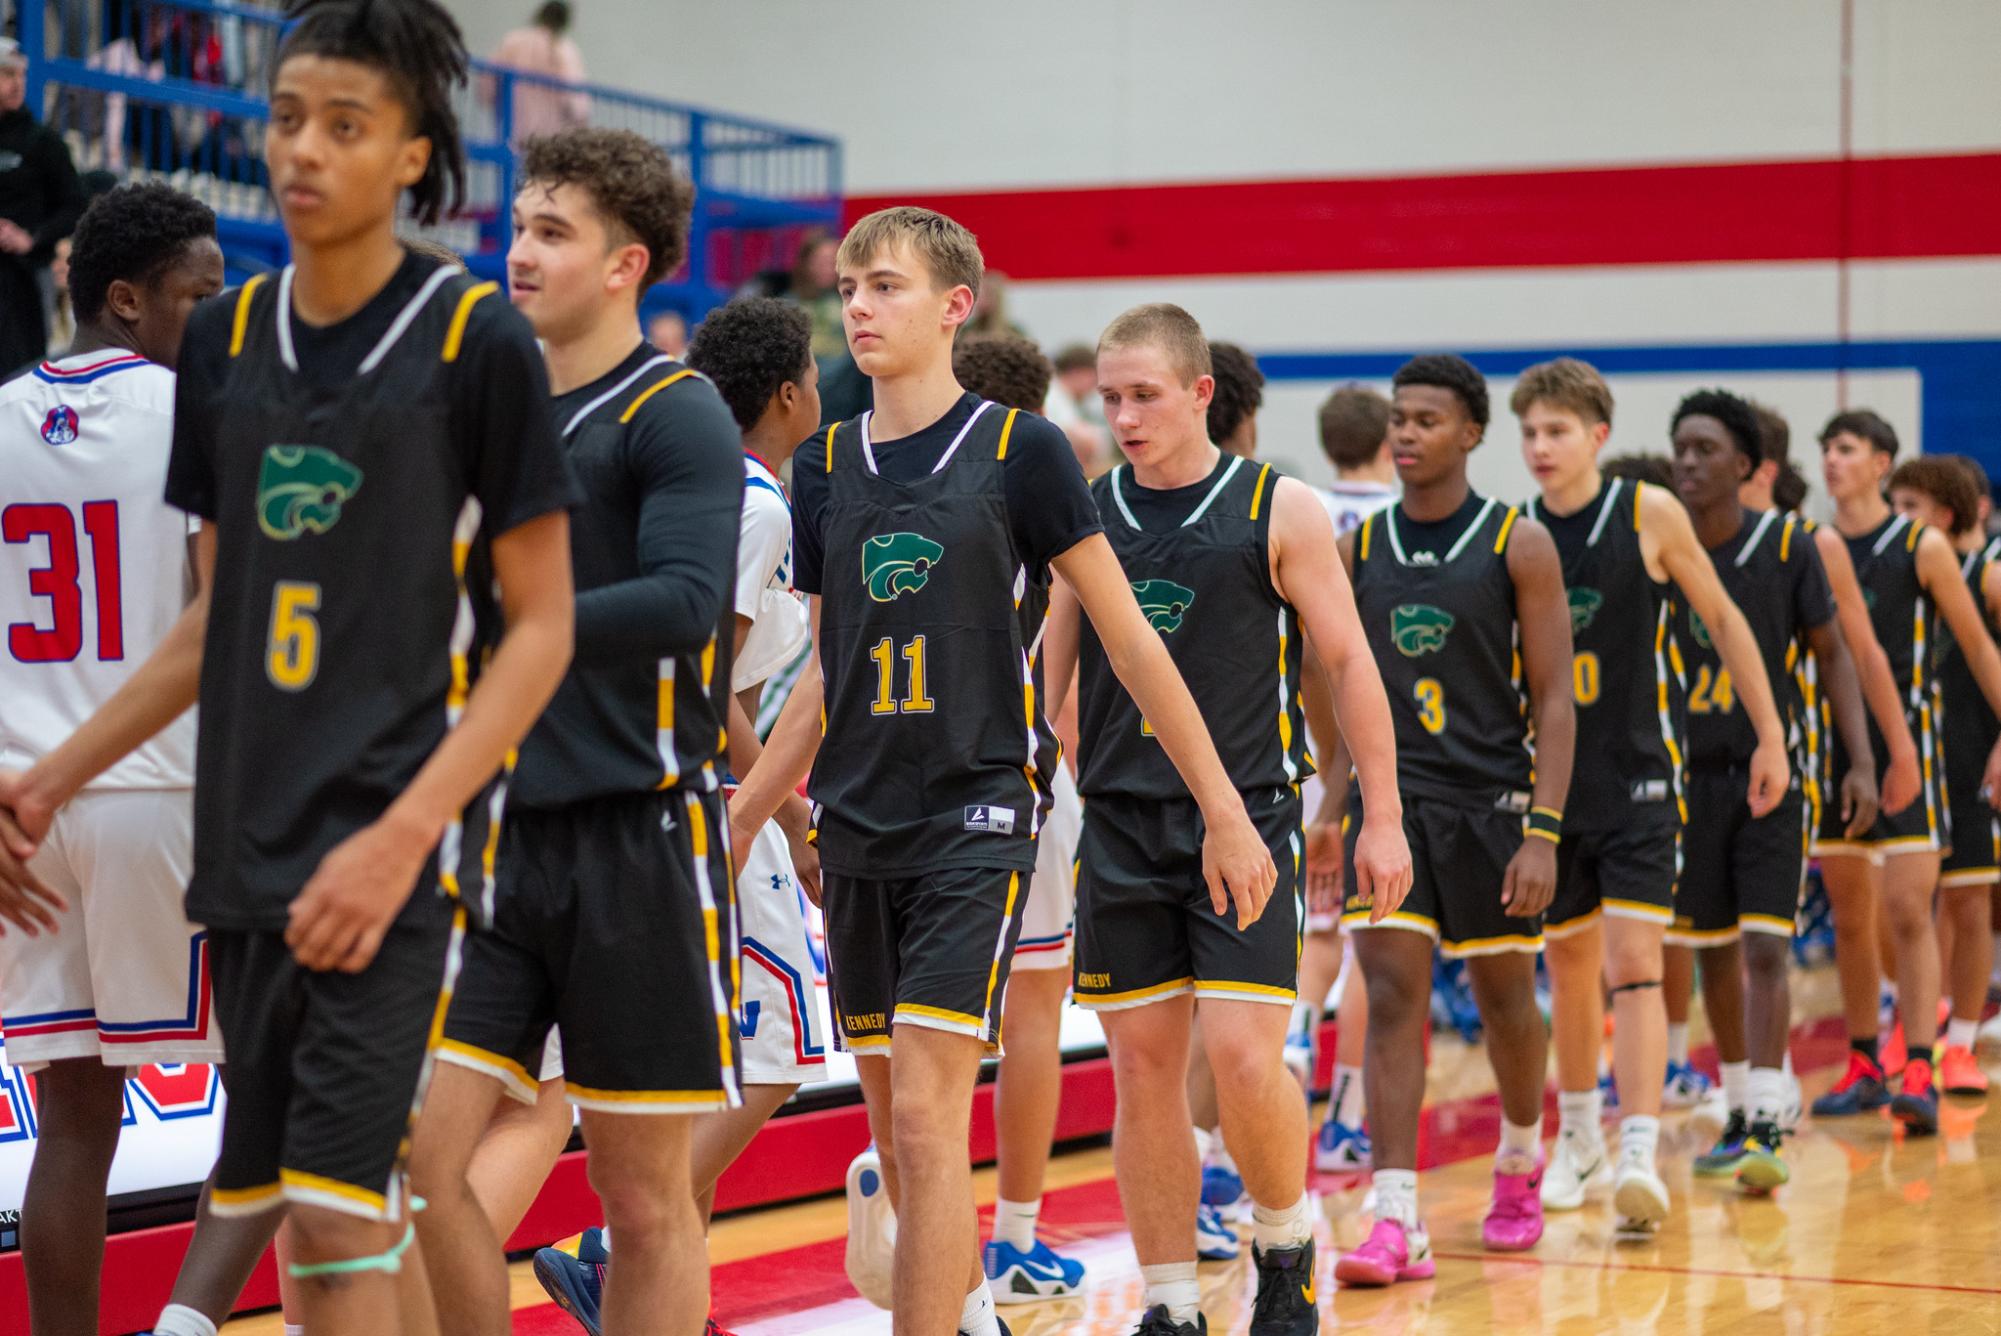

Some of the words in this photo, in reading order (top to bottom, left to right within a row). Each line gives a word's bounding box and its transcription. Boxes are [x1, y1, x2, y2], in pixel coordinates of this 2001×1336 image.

[2, 499, 124, 663] 31
[265, 580, 322, 692] 5
[870, 635, 934, 715] 11
[1414, 677, 1445, 734] 3
[1688, 663, 1734, 713] 24
